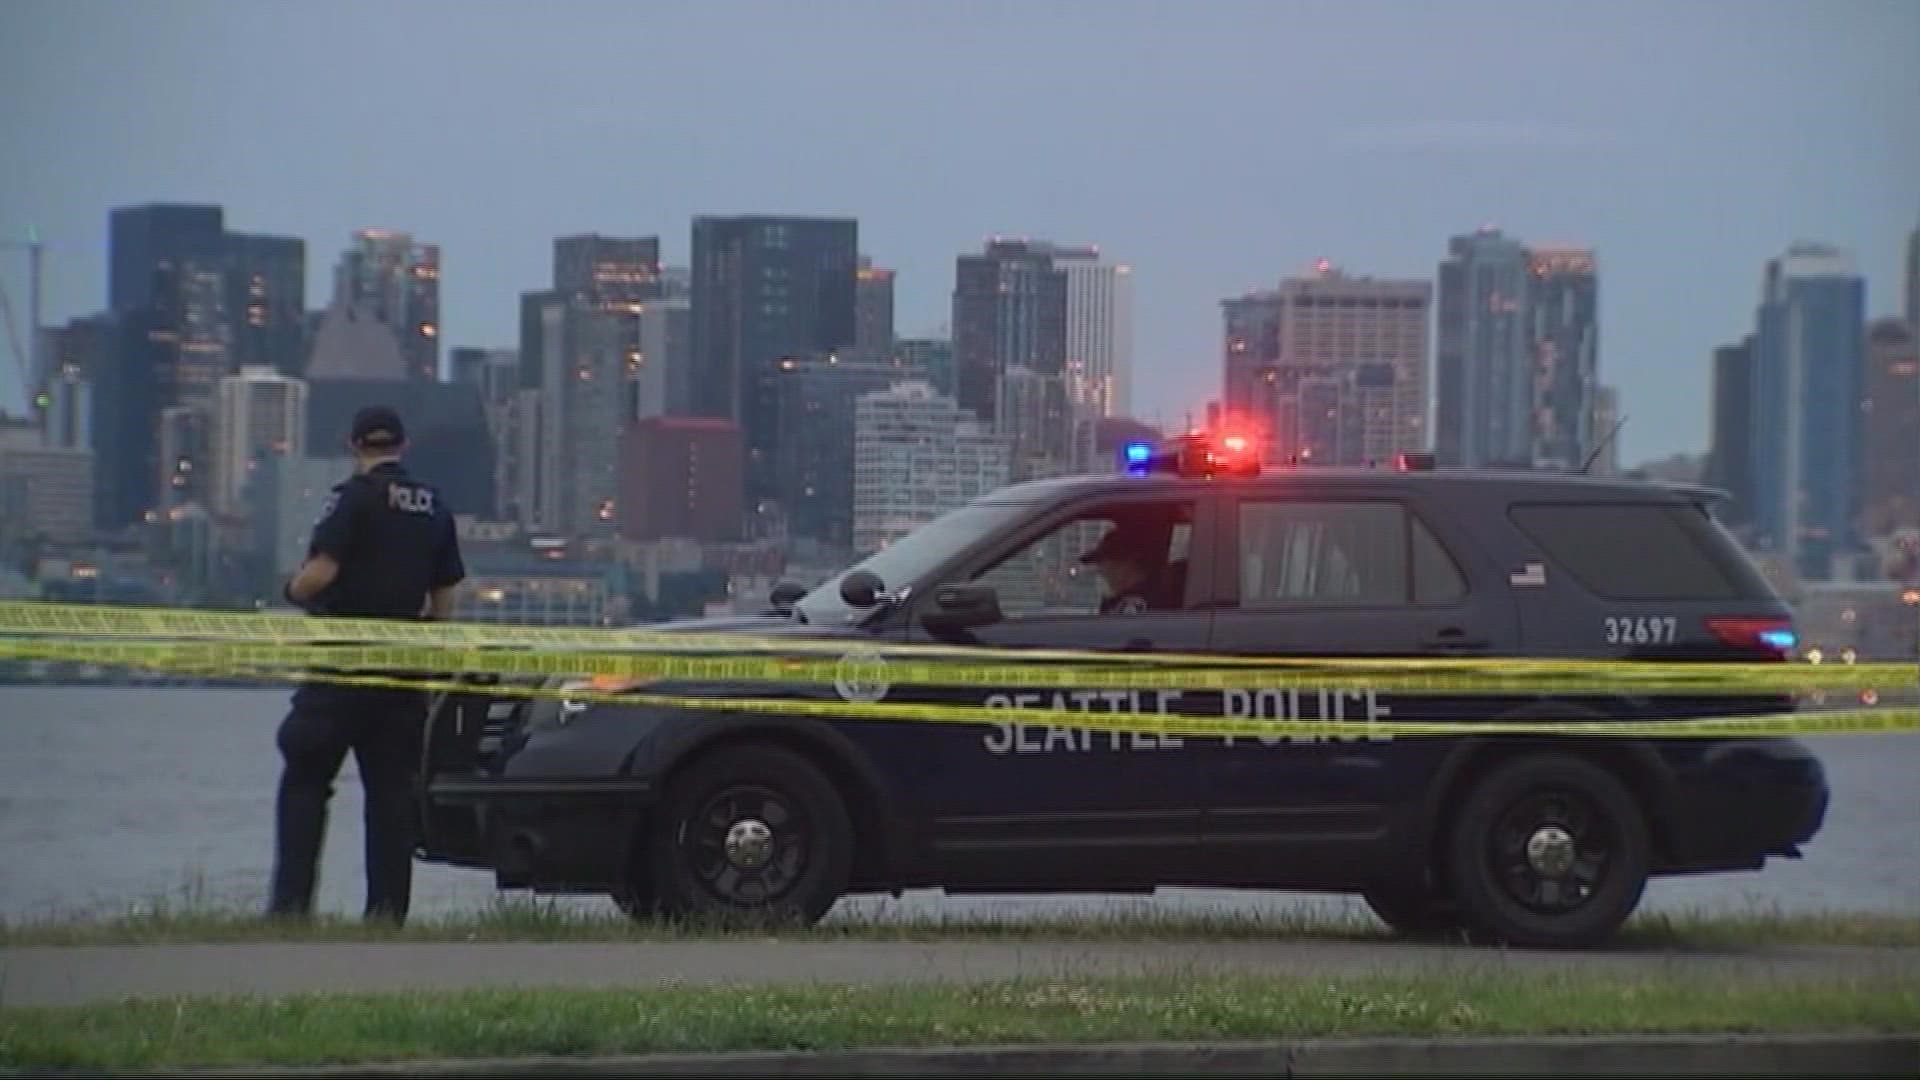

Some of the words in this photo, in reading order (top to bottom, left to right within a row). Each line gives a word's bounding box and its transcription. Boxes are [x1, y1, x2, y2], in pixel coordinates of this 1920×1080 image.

[1604, 616, 1678, 644] 32697
[984, 690, 1184, 753] SEATTLE
[1223, 687, 1394, 747] POLICE
